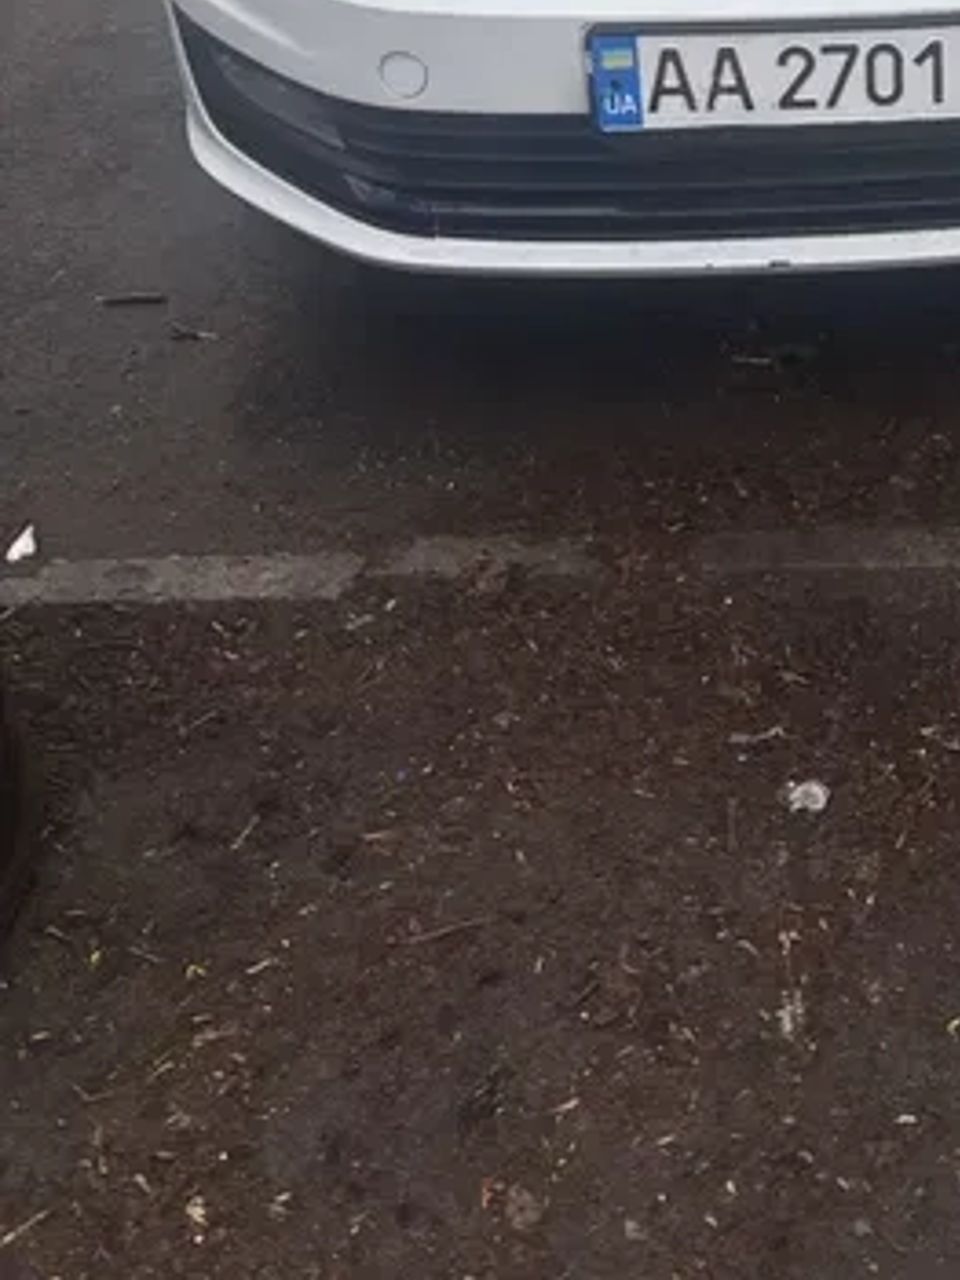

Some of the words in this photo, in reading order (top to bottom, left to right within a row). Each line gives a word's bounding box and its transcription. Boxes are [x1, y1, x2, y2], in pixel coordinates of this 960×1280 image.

[648, 48, 755, 113] AA
[775, 40, 944, 110] 2701
[603, 93, 638, 115] UA
